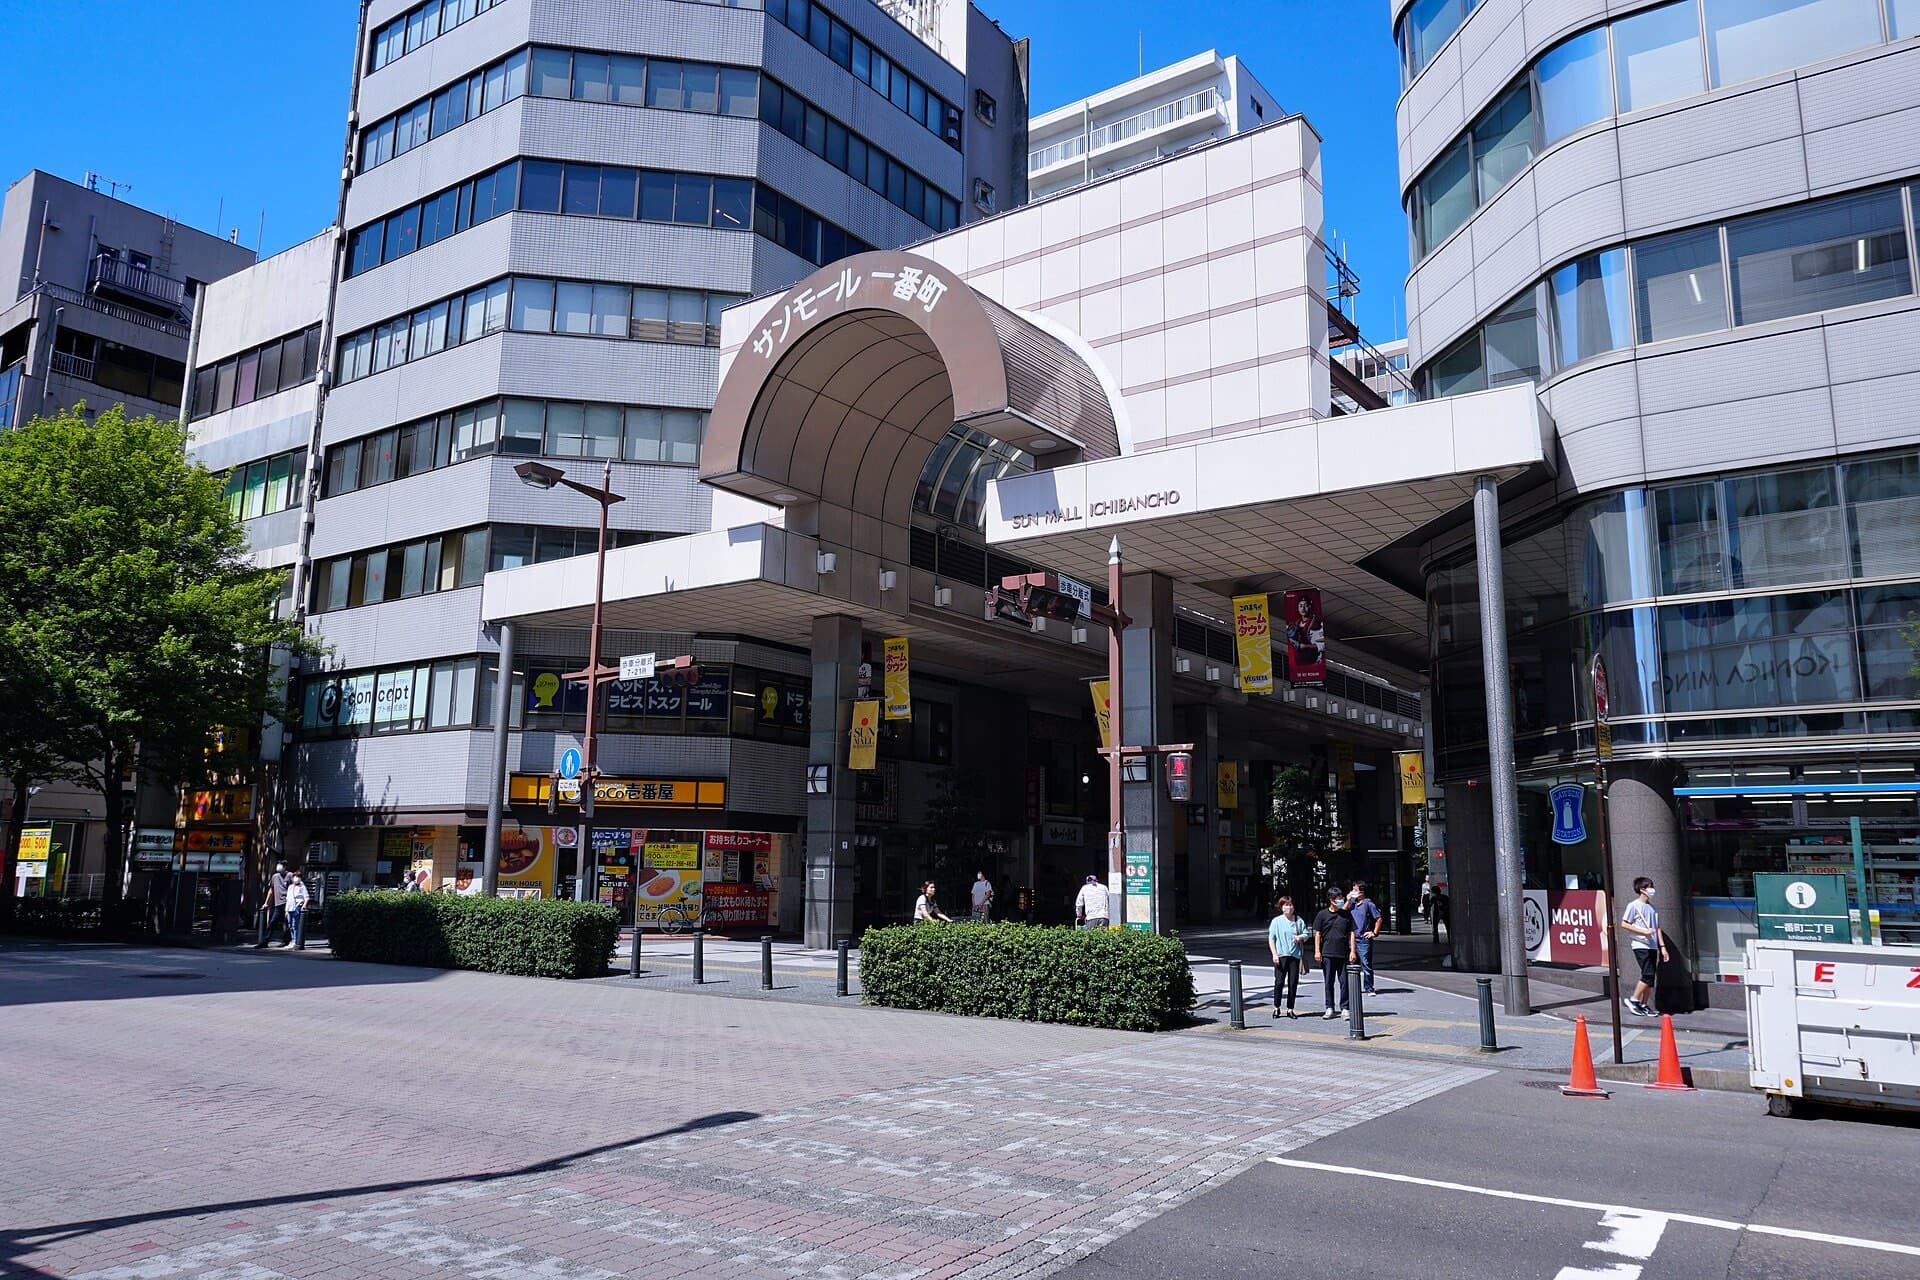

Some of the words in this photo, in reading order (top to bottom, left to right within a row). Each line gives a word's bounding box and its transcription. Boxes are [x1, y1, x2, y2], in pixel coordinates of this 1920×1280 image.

[753, 268, 862, 359] サンモール
[871, 266, 948, 312] 一番町
[1012, 514, 1039, 530] SUN
[1045, 506, 1083, 524] MALL
[1089, 490, 1180, 518] ICHIBANCHO
[1237, 613, 1267, 626] ホーム
[1238, 624, 1267, 637] タウン
[886, 652, 907, 663] ホーム
[886, 662, 908, 673] タウン
[854, 727, 875, 738] SUN
[1403, 773, 1423, 781] SUN
[1551, 908, 1593, 927] MACHI
[1774, 922, 1835, 934] 一番町二丁目
[1559, 928, 1587, 945] café
[1814, 962, 1836, 983] E
